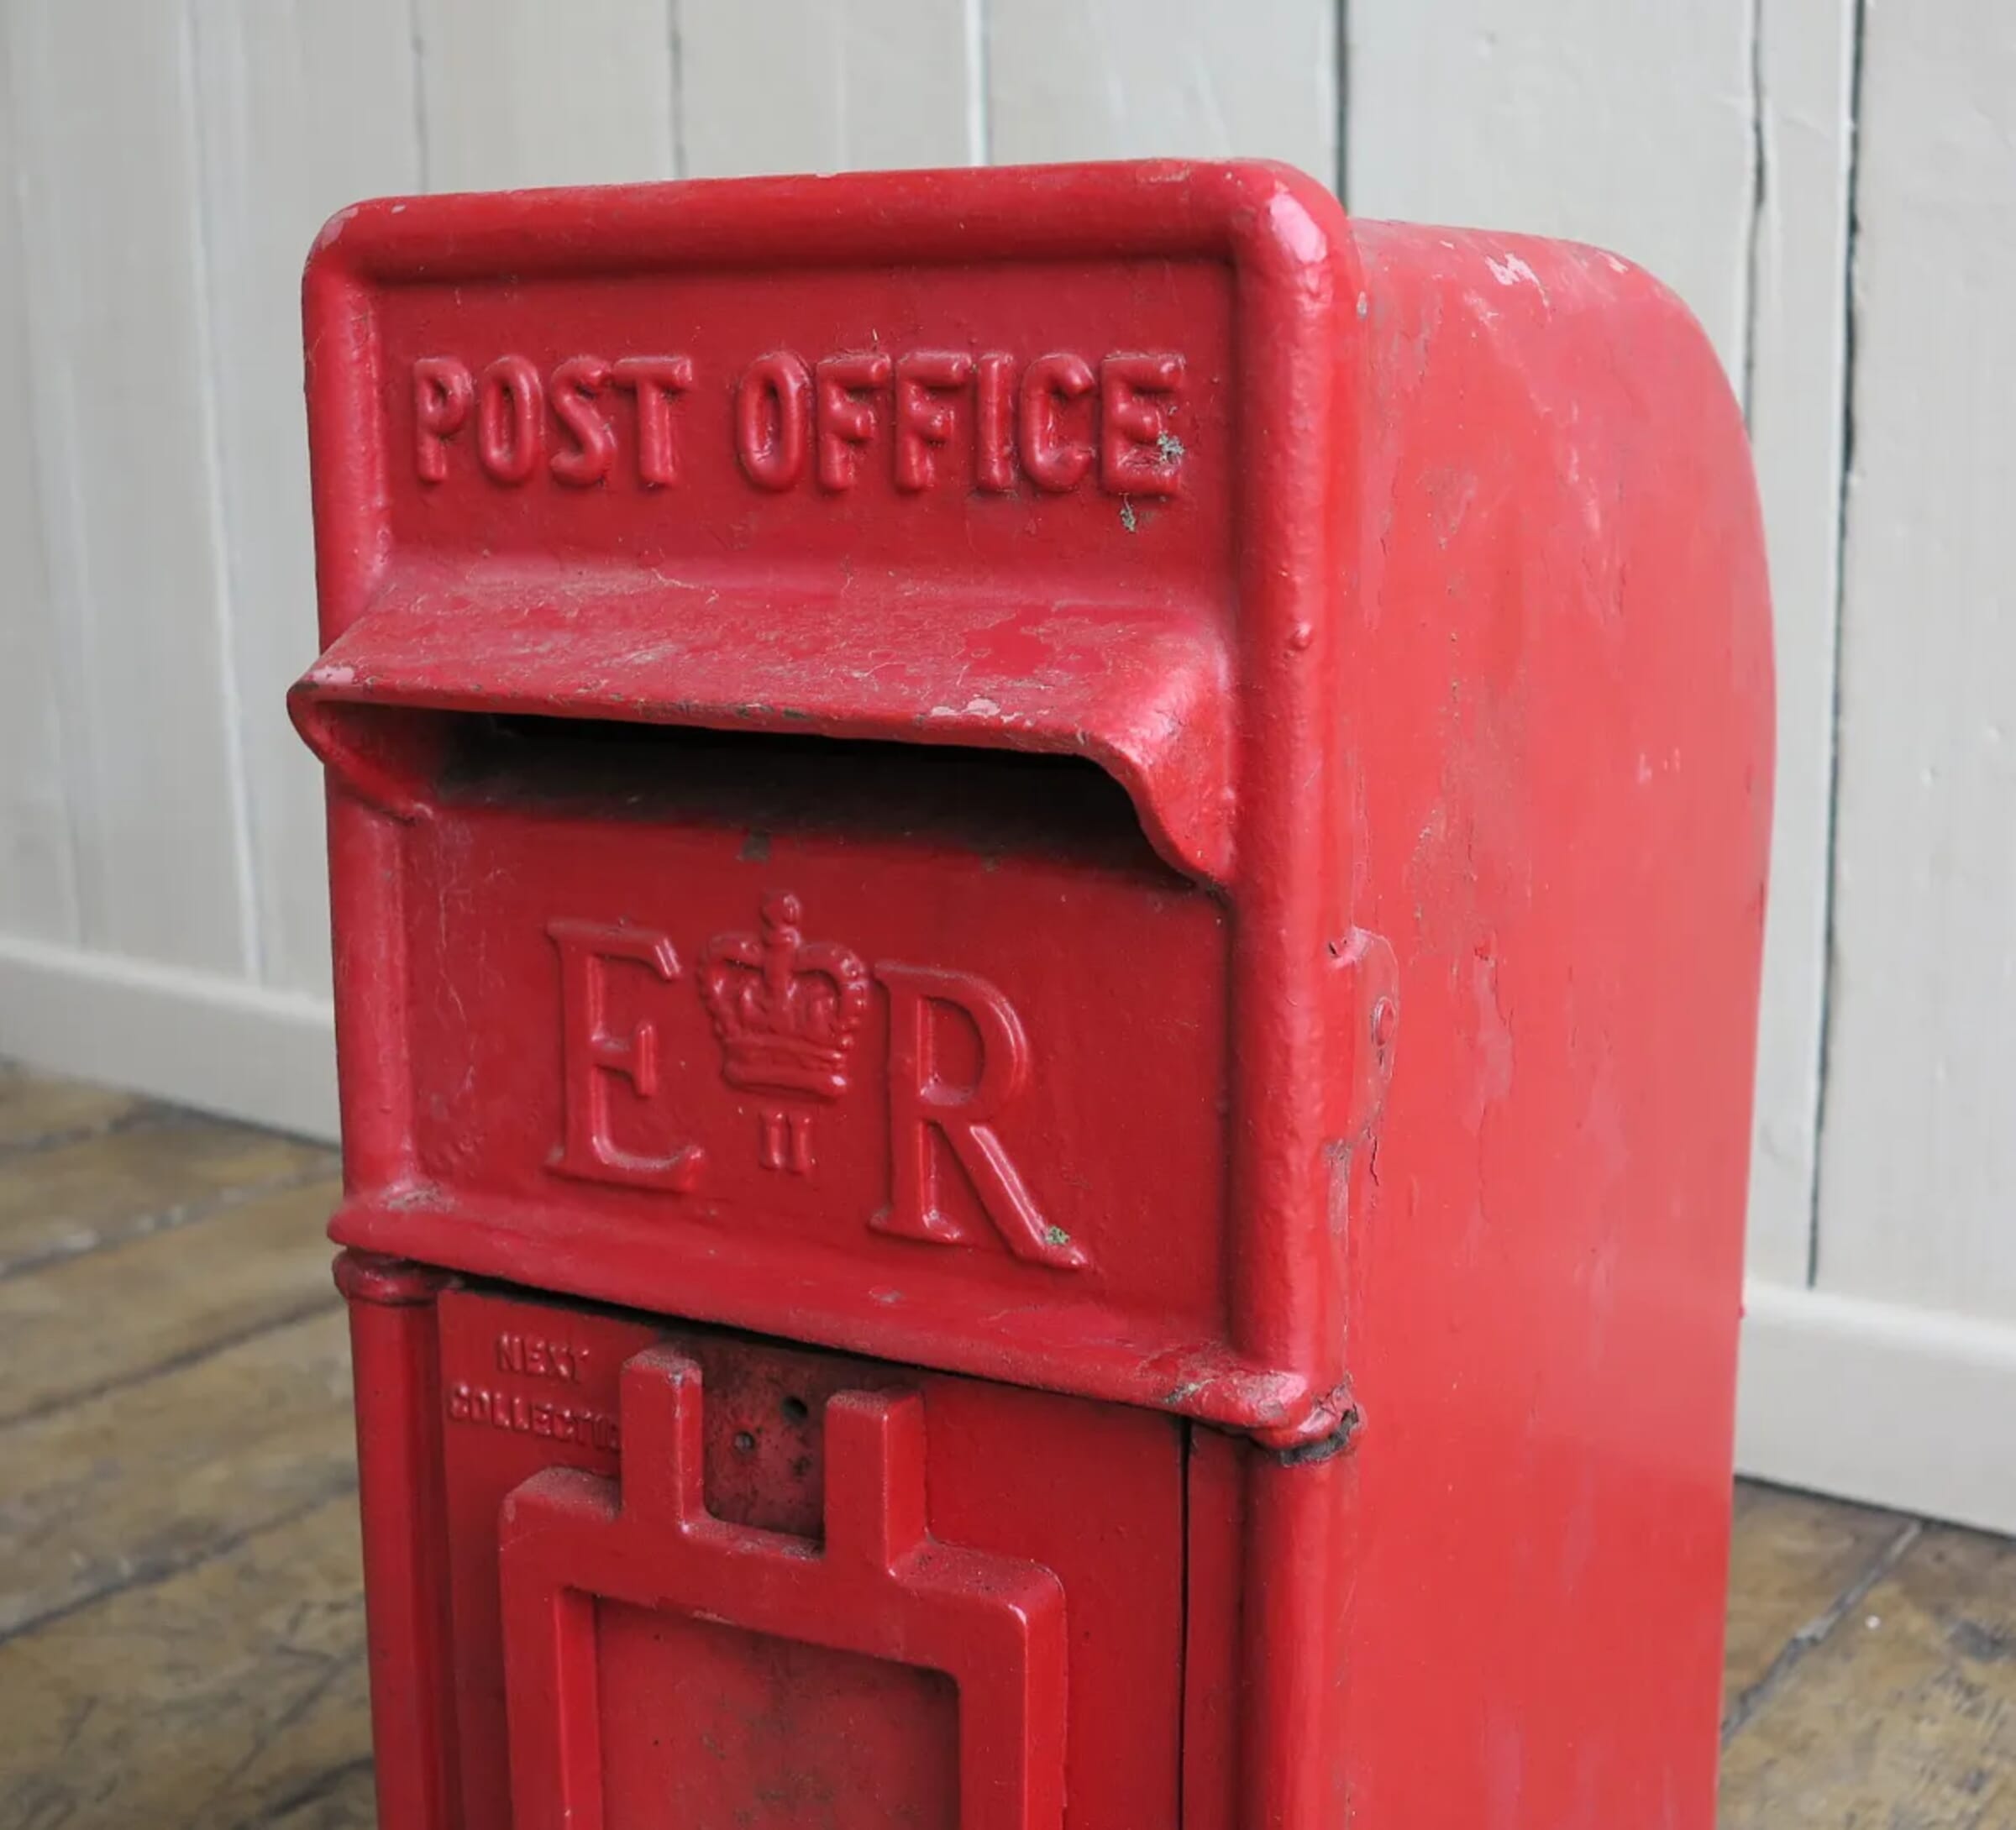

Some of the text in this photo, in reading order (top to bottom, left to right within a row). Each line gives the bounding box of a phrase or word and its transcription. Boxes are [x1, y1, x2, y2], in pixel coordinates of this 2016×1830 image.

[412, 349, 1186, 496] POST OFFICE
[544, 917, 1089, 1270] E R
[760, 1110, 816, 1174] II
[495, 1333, 590, 1384] NEXT
[449, 1387, 621, 1454] COLLECTIO
